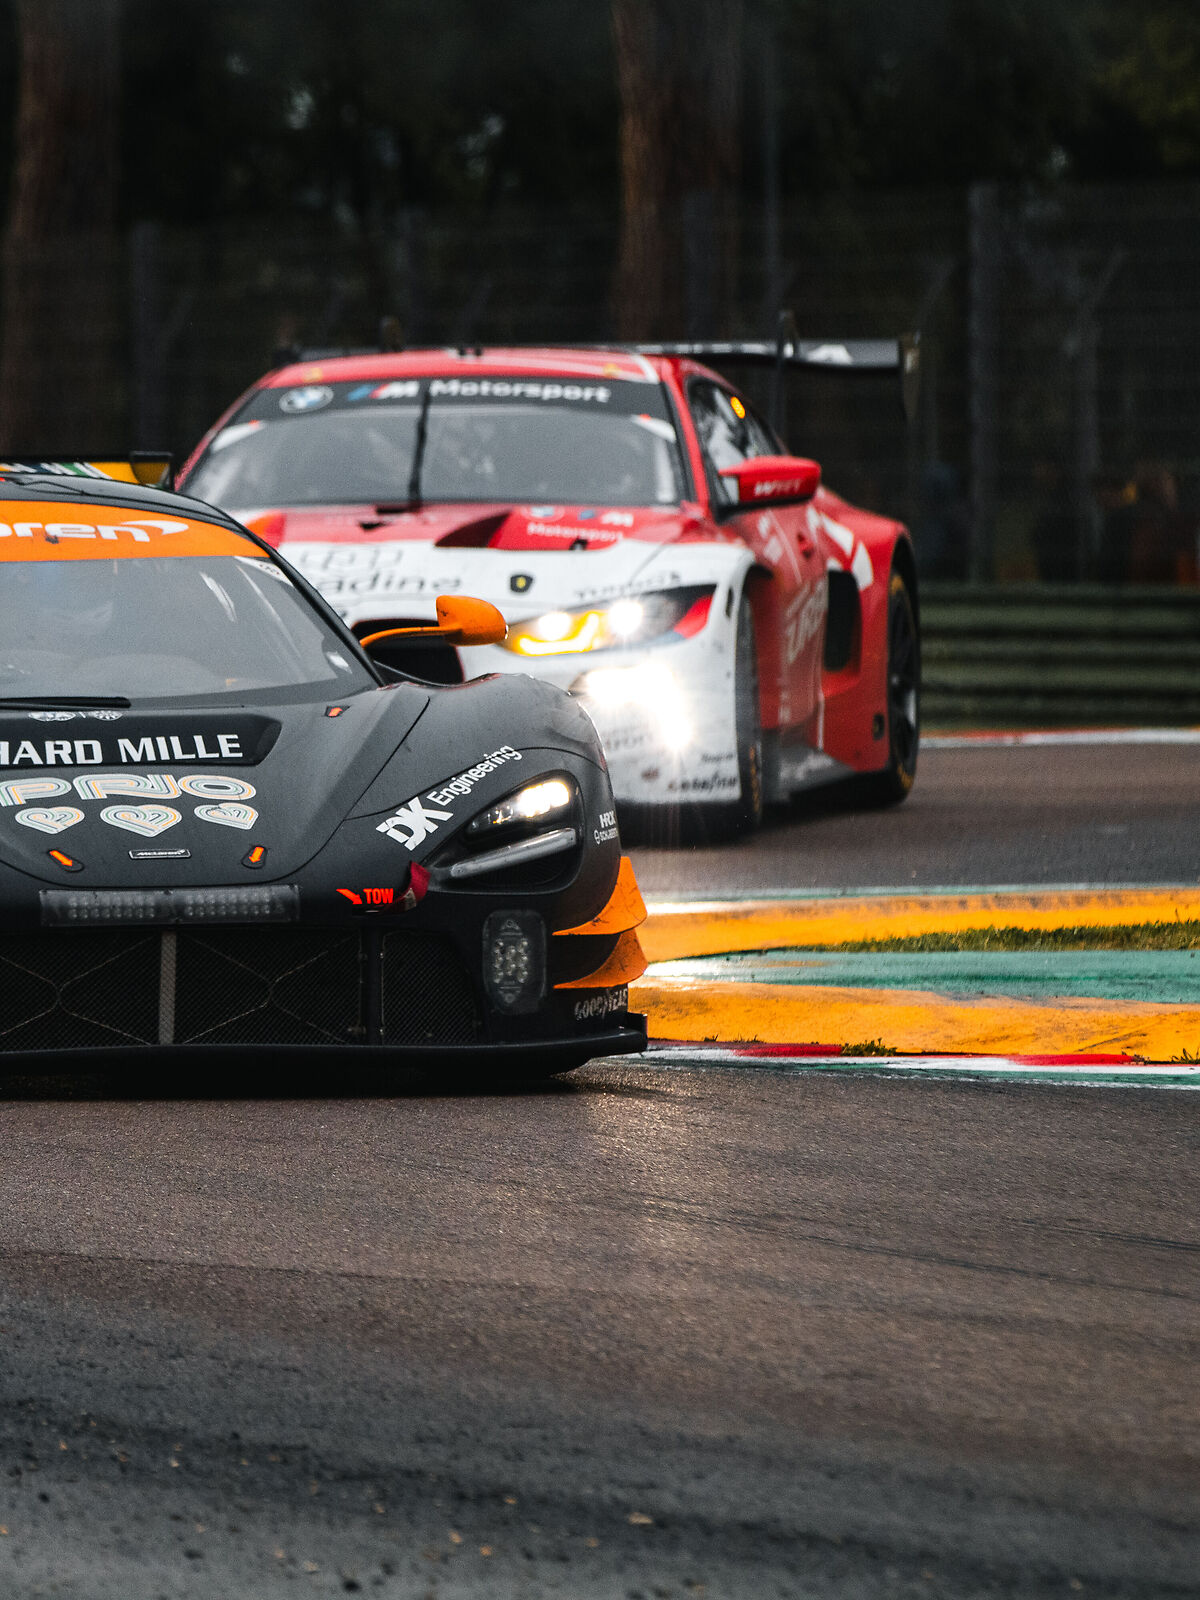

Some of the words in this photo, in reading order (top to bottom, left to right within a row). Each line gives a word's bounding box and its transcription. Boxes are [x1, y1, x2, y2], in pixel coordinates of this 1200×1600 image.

[429, 379, 611, 403] Motorsport
[527, 522, 623, 541] Motorsport
[117, 734, 244, 763] MILLE
[375, 796, 454, 851] DK
[426, 744, 523, 807] Engineering
[363, 888, 394, 905] TOW
